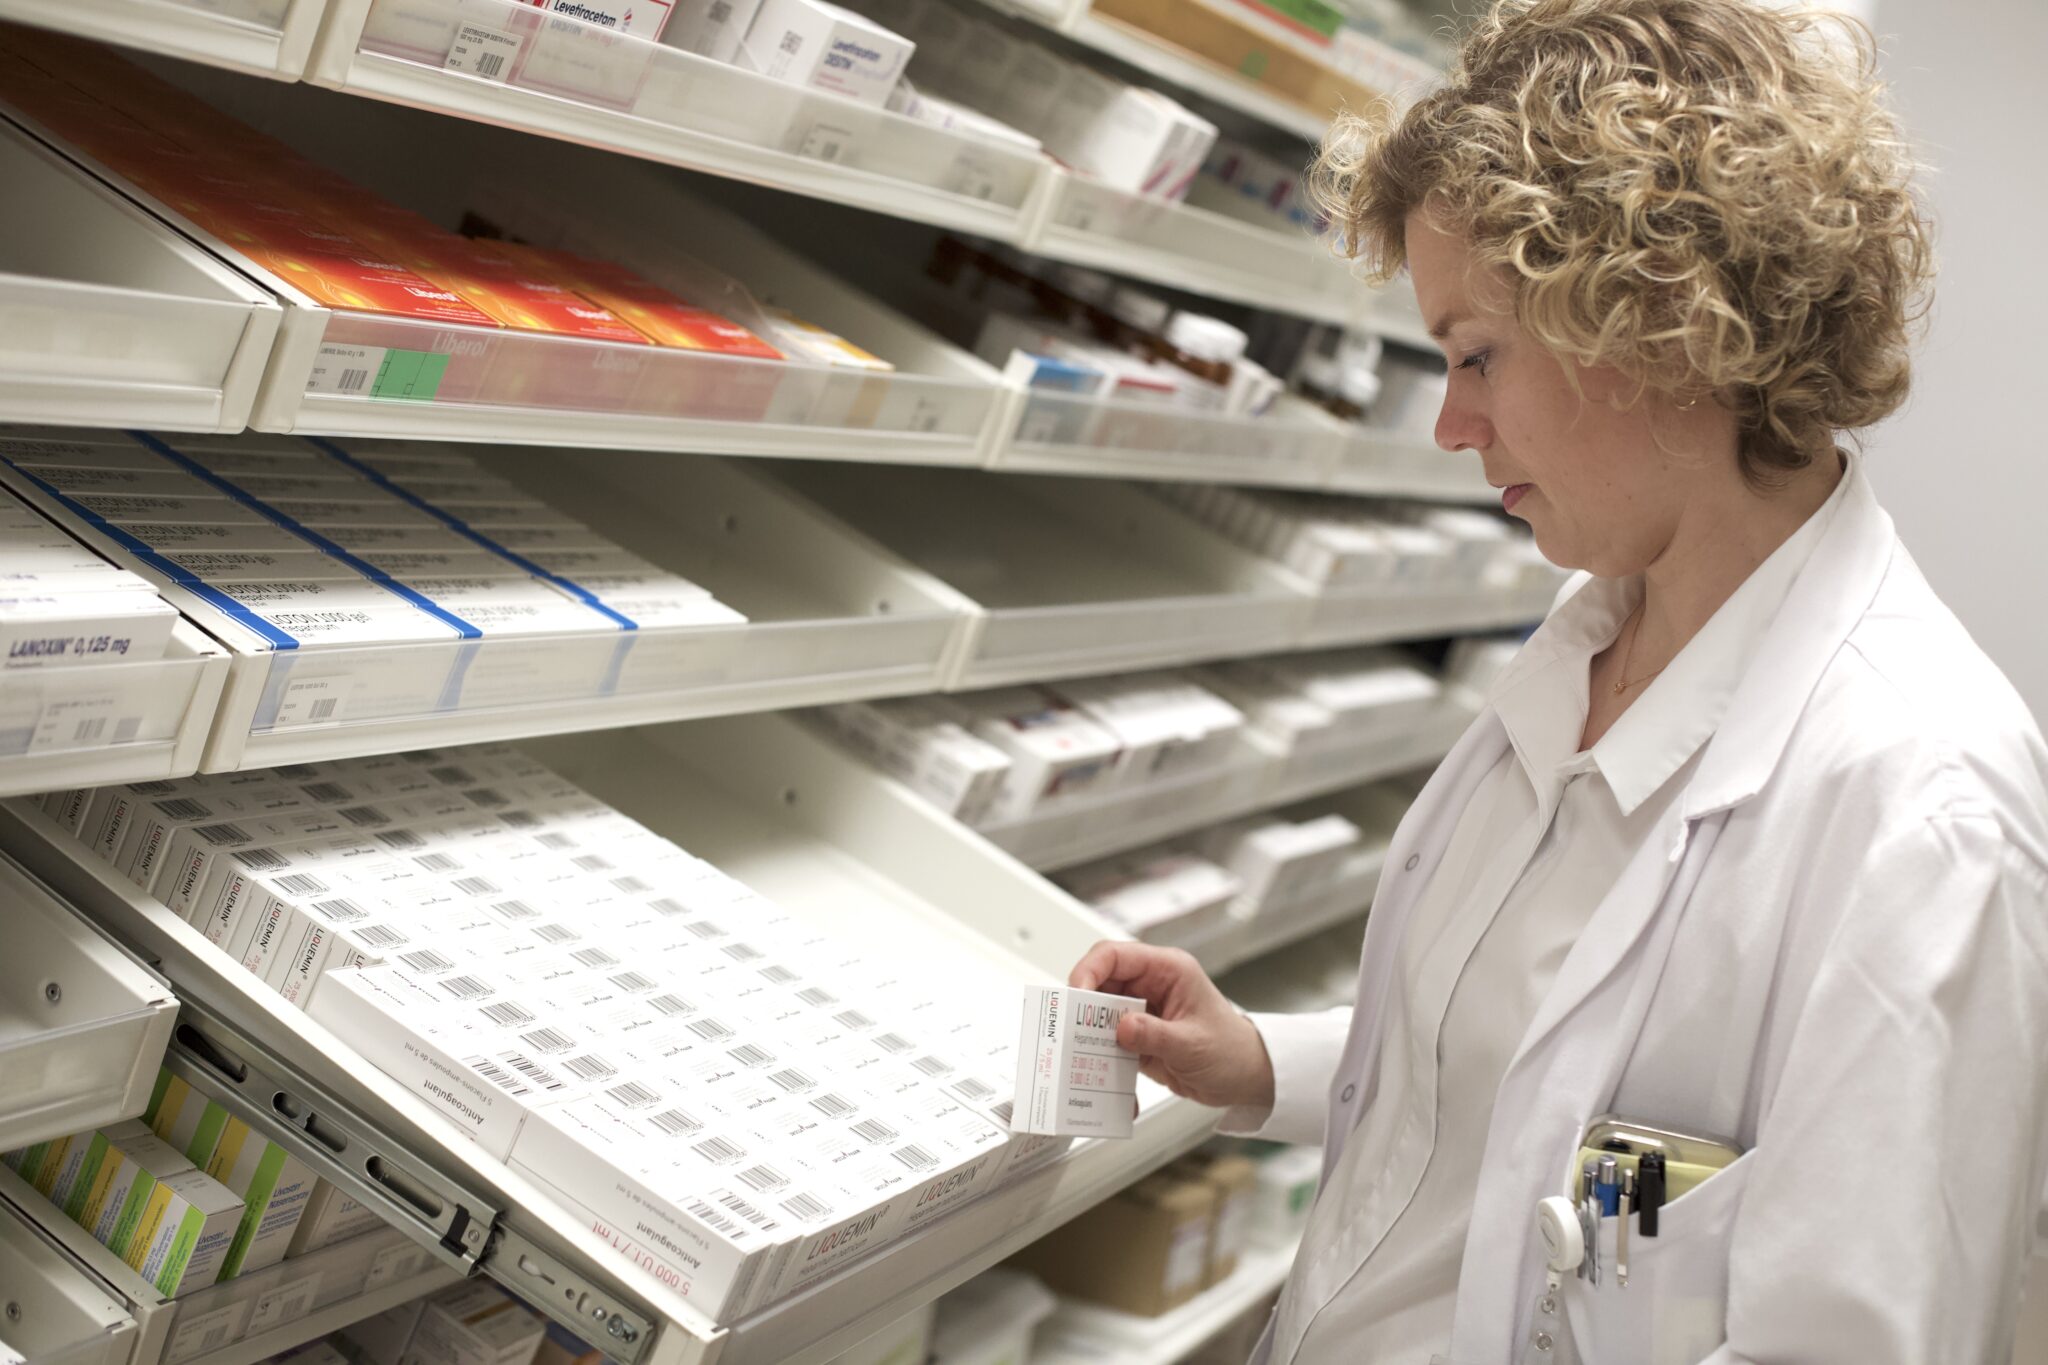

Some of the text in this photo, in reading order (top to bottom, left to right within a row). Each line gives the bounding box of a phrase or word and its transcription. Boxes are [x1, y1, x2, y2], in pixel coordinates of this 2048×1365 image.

[554, 0, 616, 27] Levetiracetam
[267, 582, 304, 593] 1000
[263, 613, 319, 625] LIOTON
[315, 613, 352, 624] 1000
[74, 636, 111, 657] 0,125
[110, 638, 131, 655] mg
[404, 1041, 414, 1052] ml
[414, 1048, 420, 1056] 5
[420, 1053, 429, 1061] de
[423, 1079, 485, 1125] Anticoagulant
[636, 1221, 701, 1269] Anticoagulant
[592, 1220, 691, 1296] 5 000 U.I. / 1 ml
